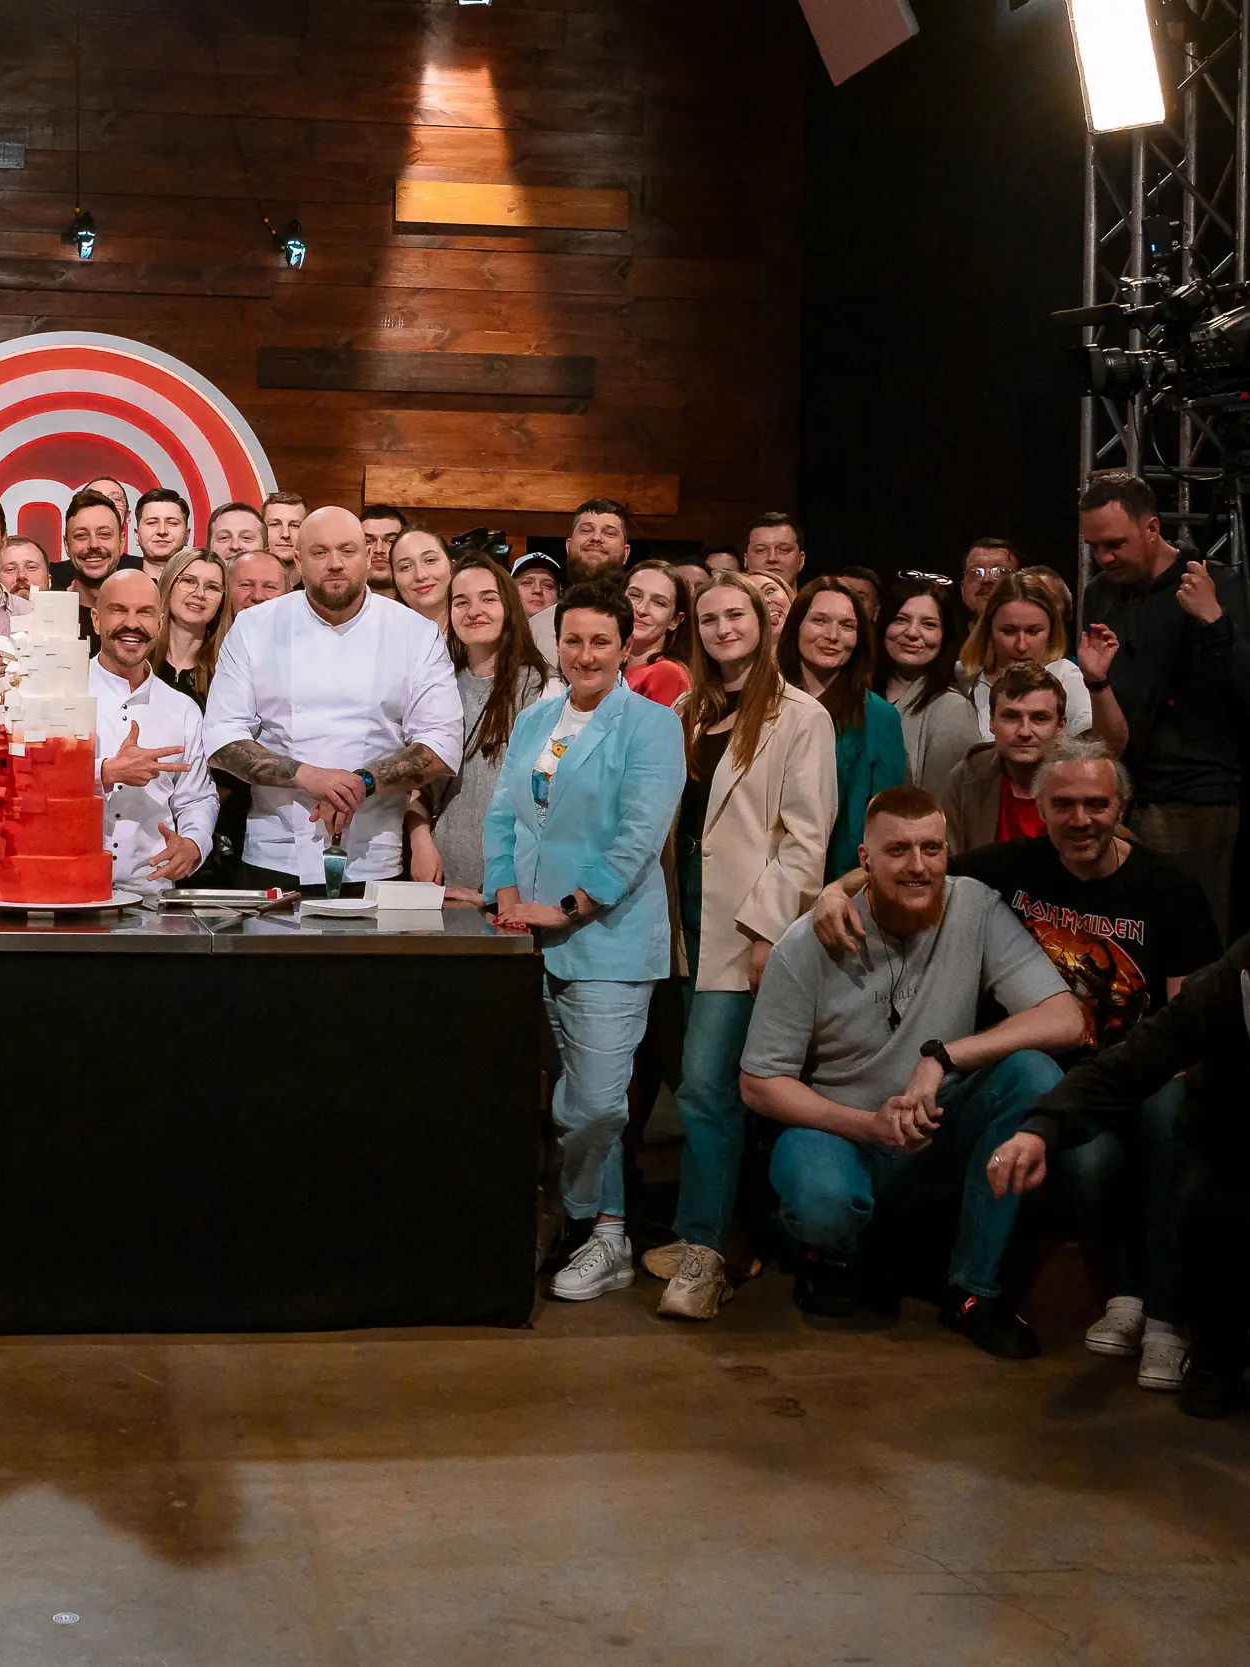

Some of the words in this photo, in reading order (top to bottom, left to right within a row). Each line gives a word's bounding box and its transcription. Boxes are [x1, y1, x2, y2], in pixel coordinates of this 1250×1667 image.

[1012, 889, 1059, 929] IRON
[1062, 908, 1145, 946] MAIDEN
[873, 986, 920, 1004] lesure
